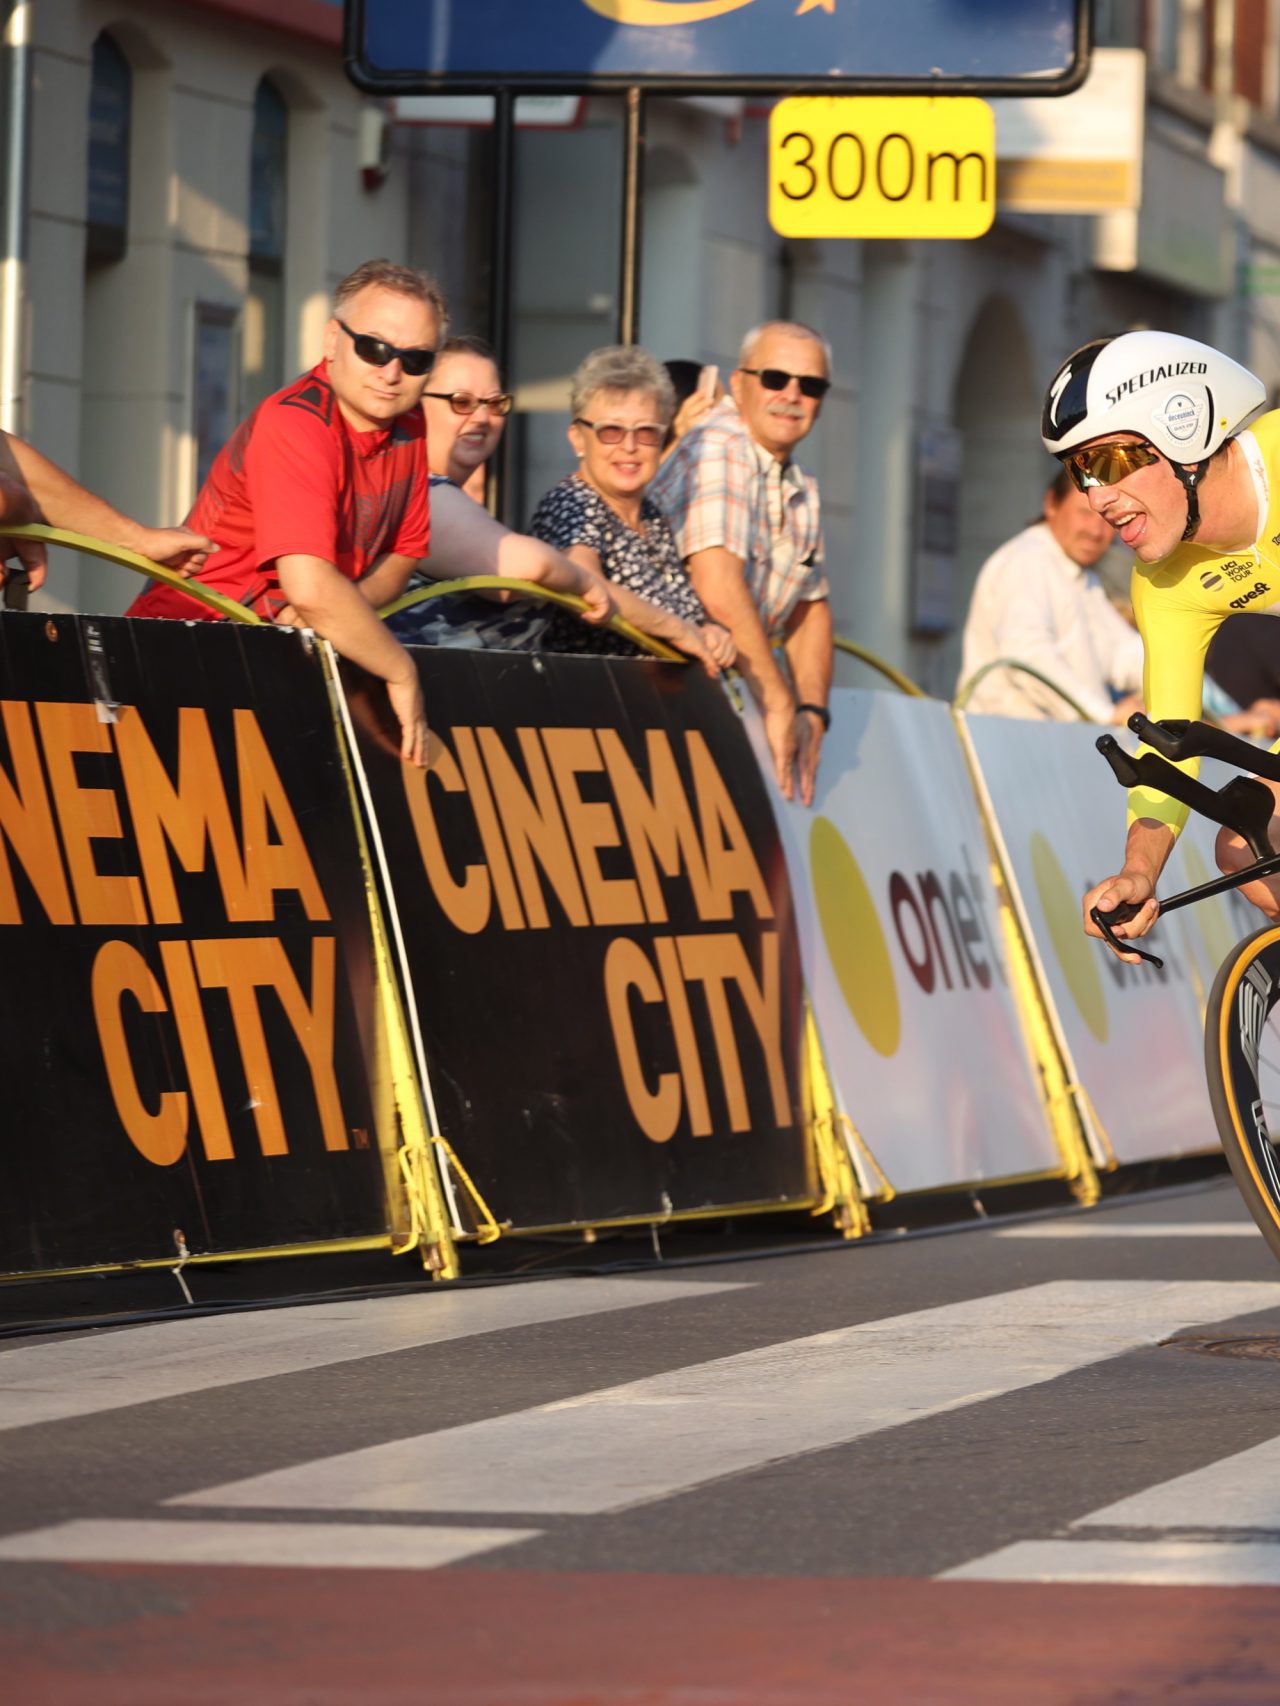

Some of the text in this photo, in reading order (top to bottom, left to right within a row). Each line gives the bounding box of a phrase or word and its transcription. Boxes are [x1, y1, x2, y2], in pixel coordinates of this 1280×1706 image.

[777, 132, 988, 202] 300m
[1105, 361, 1208, 408] SPECIALIZED
[1220, 560, 1238, 572] UCI
[1225, 561, 1254, 577] WORLD
[1230, 569, 1253, 583] TOUR
[1229, 582, 1271, 609] quest
[405, 725, 776, 935] CINEMA
[91, 936, 351, 1167] CITY
[604, 932, 793, 1144] CITY
